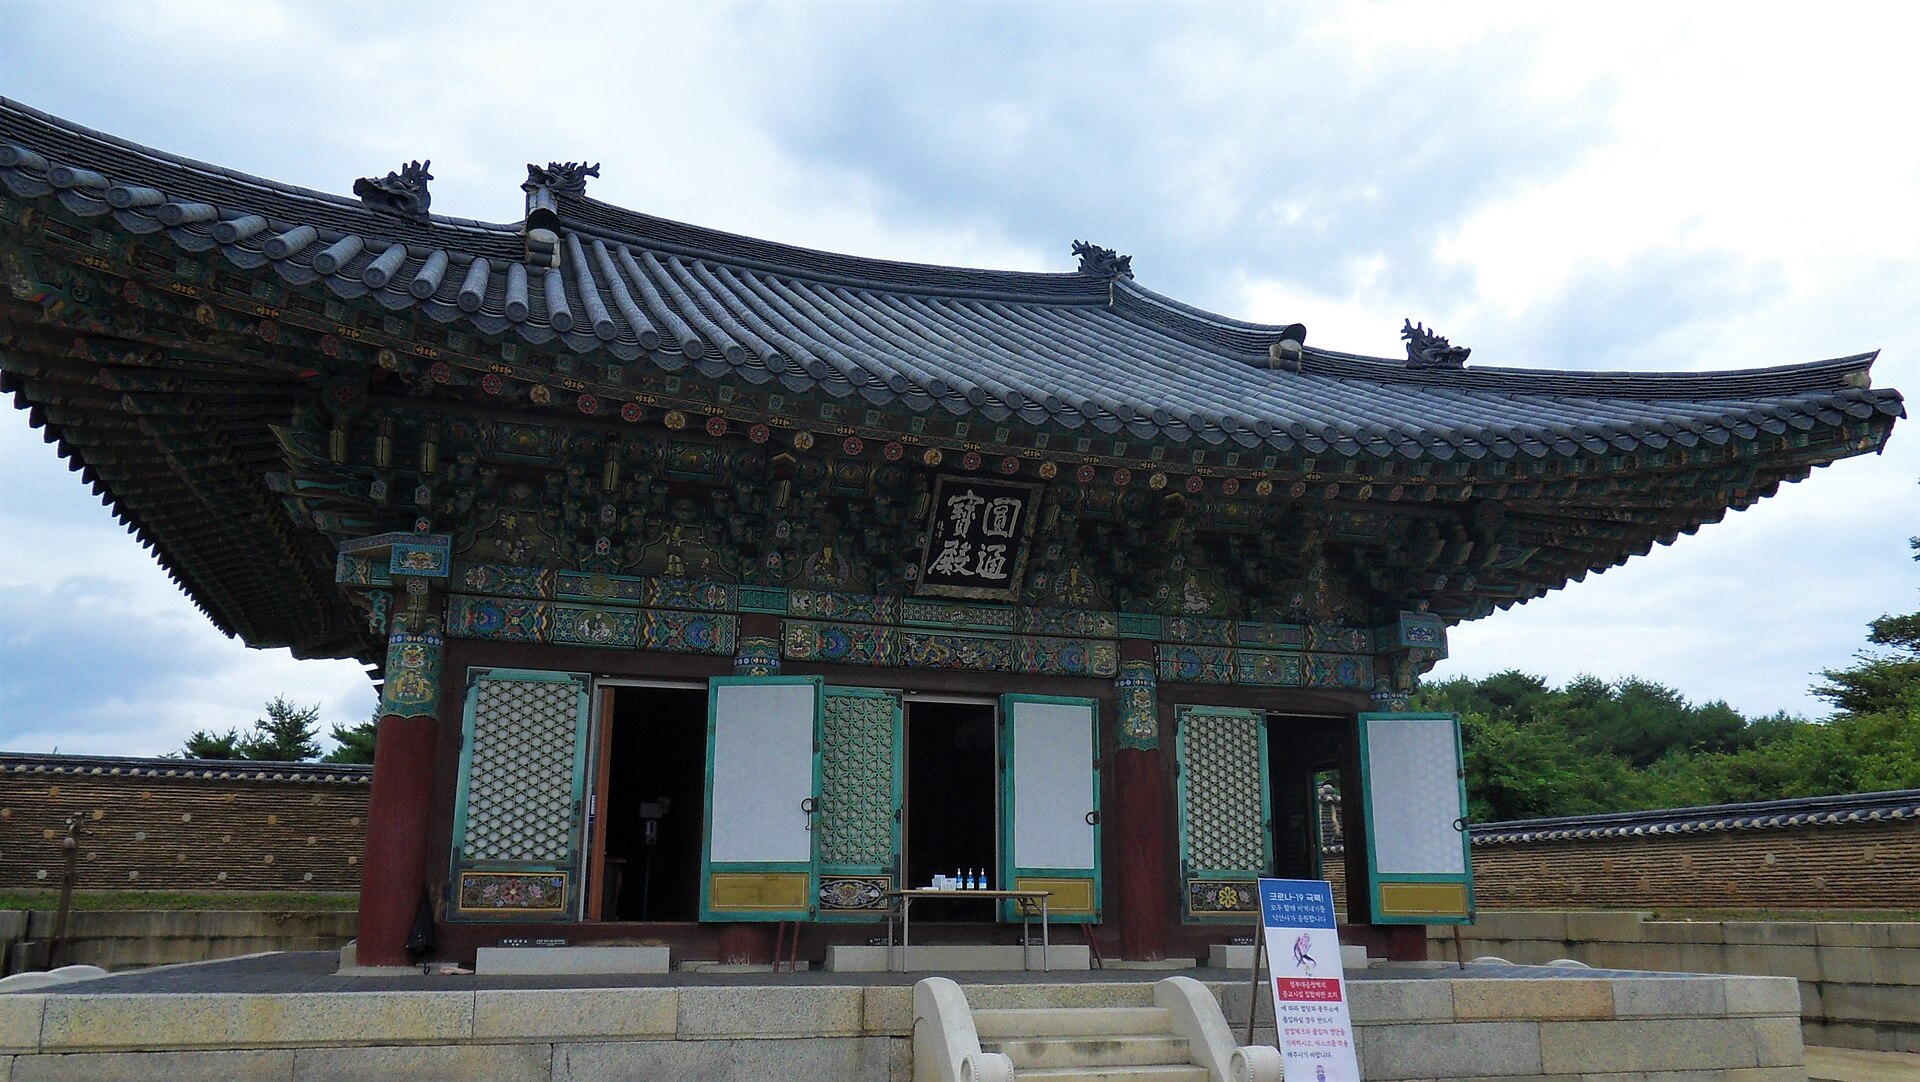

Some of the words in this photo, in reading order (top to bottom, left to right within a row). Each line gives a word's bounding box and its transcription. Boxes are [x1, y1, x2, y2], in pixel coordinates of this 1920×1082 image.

[1269, 892, 1304, 901] 코로나-19
[1306, 893, 1324, 903] 극복!
[1283, 904, 1296, 912] 함께
[1297, 914, 1327, 923] 응원합니다
[1282, 990, 1304, 999] 종교시설
[1317, 1017, 1333, 1025] 반드시
